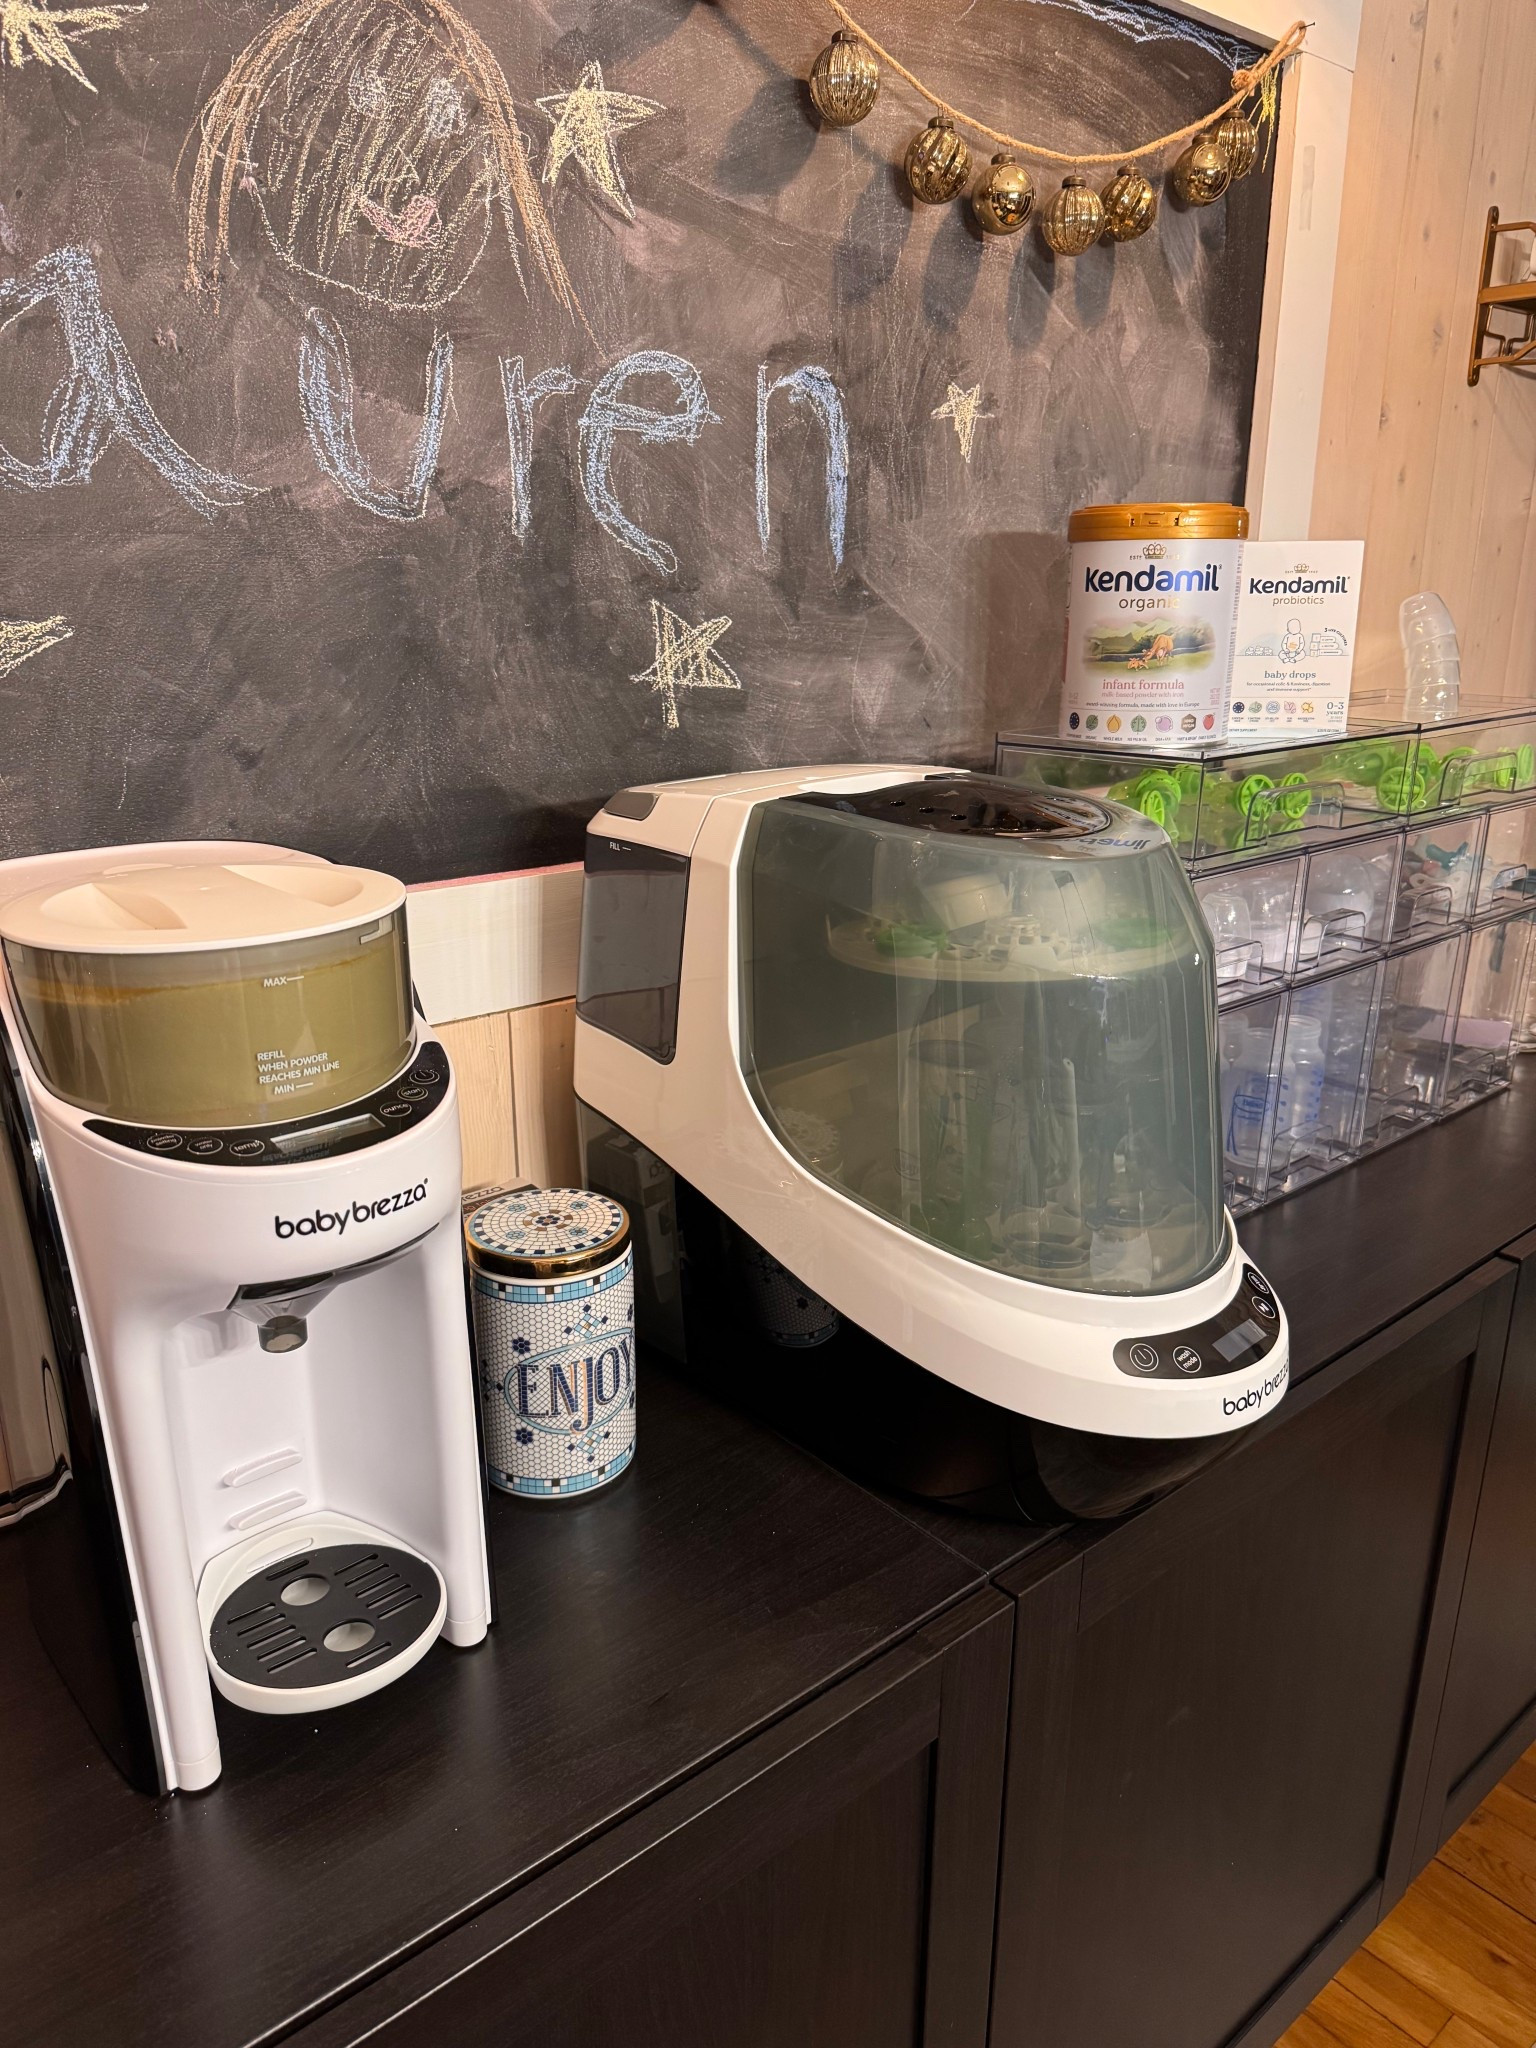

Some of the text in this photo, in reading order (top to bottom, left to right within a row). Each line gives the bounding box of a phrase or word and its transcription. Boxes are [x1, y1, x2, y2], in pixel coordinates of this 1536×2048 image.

[1085, 563, 1219, 592] Kendamil
[1249, 576, 1348, 594] Kendamil
[1119, 595, 1180, 612] organic
[1272, 595, 1325, 606] probiotics
[1264, 670, 1317, 680] baby drops
[1102, 679, 1185, 690] infant formula
[609, 841, 621, 851] FILL
[263, 976, 287, 988] MAX
[256, 1050, 286, 1061] REFILL
[257, 1052, 329, 1073] WHEN POWDER
[258, 1060, 341, 1084] REACHES MIN LINE
[274, 1083, 295, 1095] MIN
[1176, 1349, 1192, 1362] wash
[1182, 1356, 1198, 1370] mode
[515, 1333, 634, 1435] ENJOY
